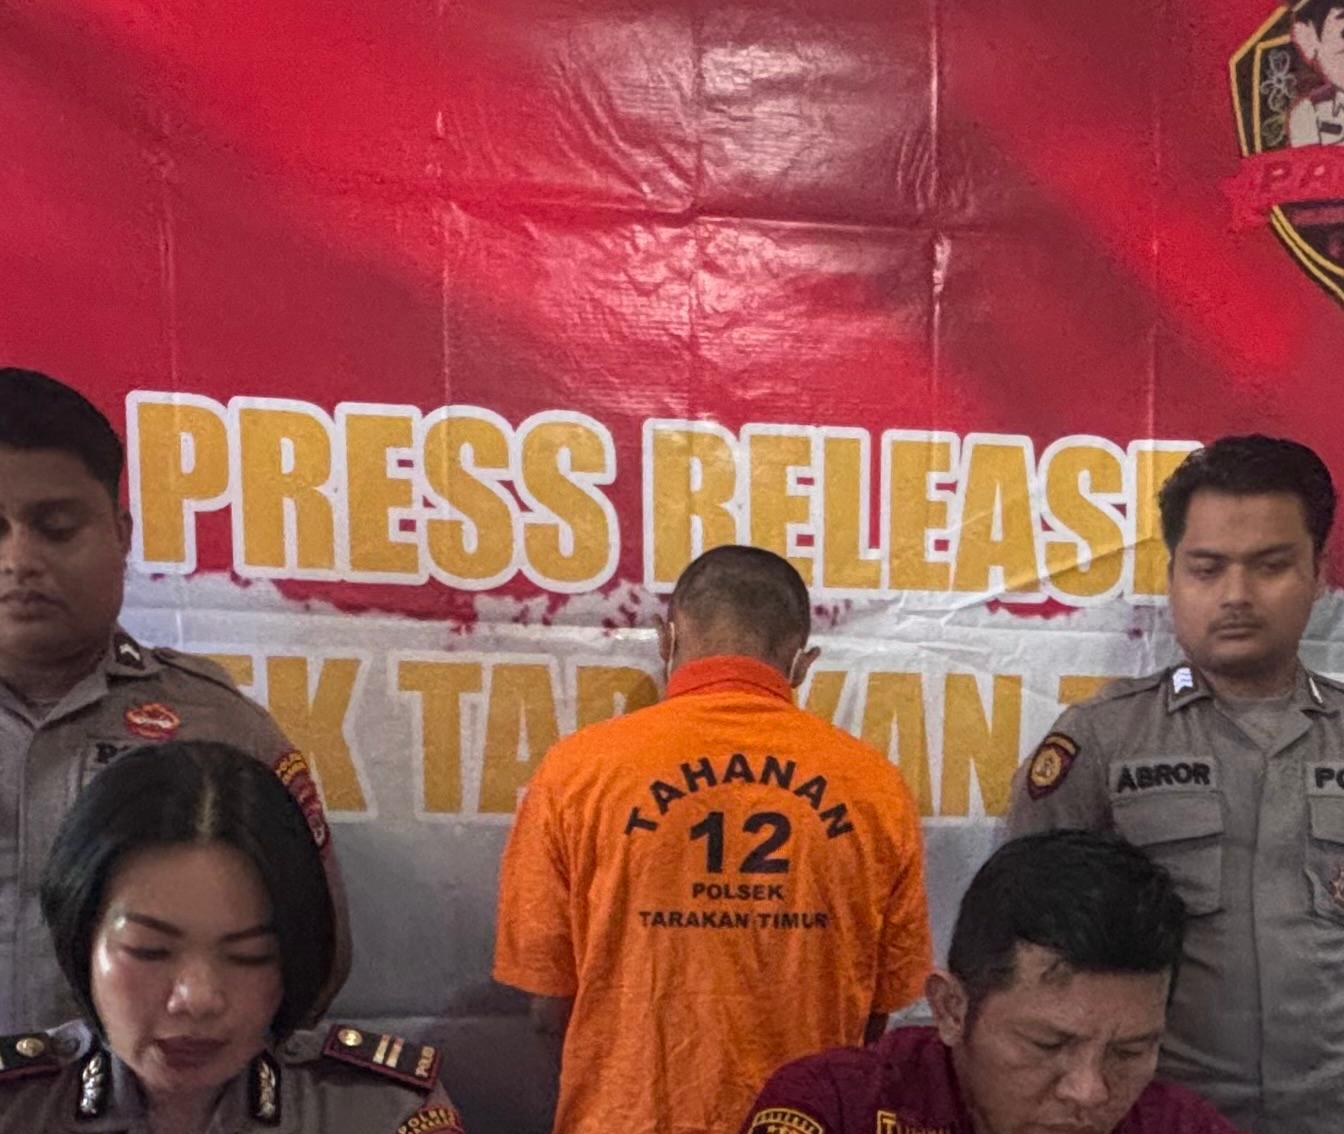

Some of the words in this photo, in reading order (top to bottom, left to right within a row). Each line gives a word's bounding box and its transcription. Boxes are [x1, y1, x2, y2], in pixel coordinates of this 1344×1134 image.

[128, 391, 619, 592] PRESS
[624, 753, 854, 839] TAHANAN
[1116, 762, 1210, 793] ABROR
[689, 811, 792, 875] 12
[692, 882, 784, 901] POLSEK
[639, 911, 750, 929] TARAKAN
[758, 911, 828, 929] TIMUR
